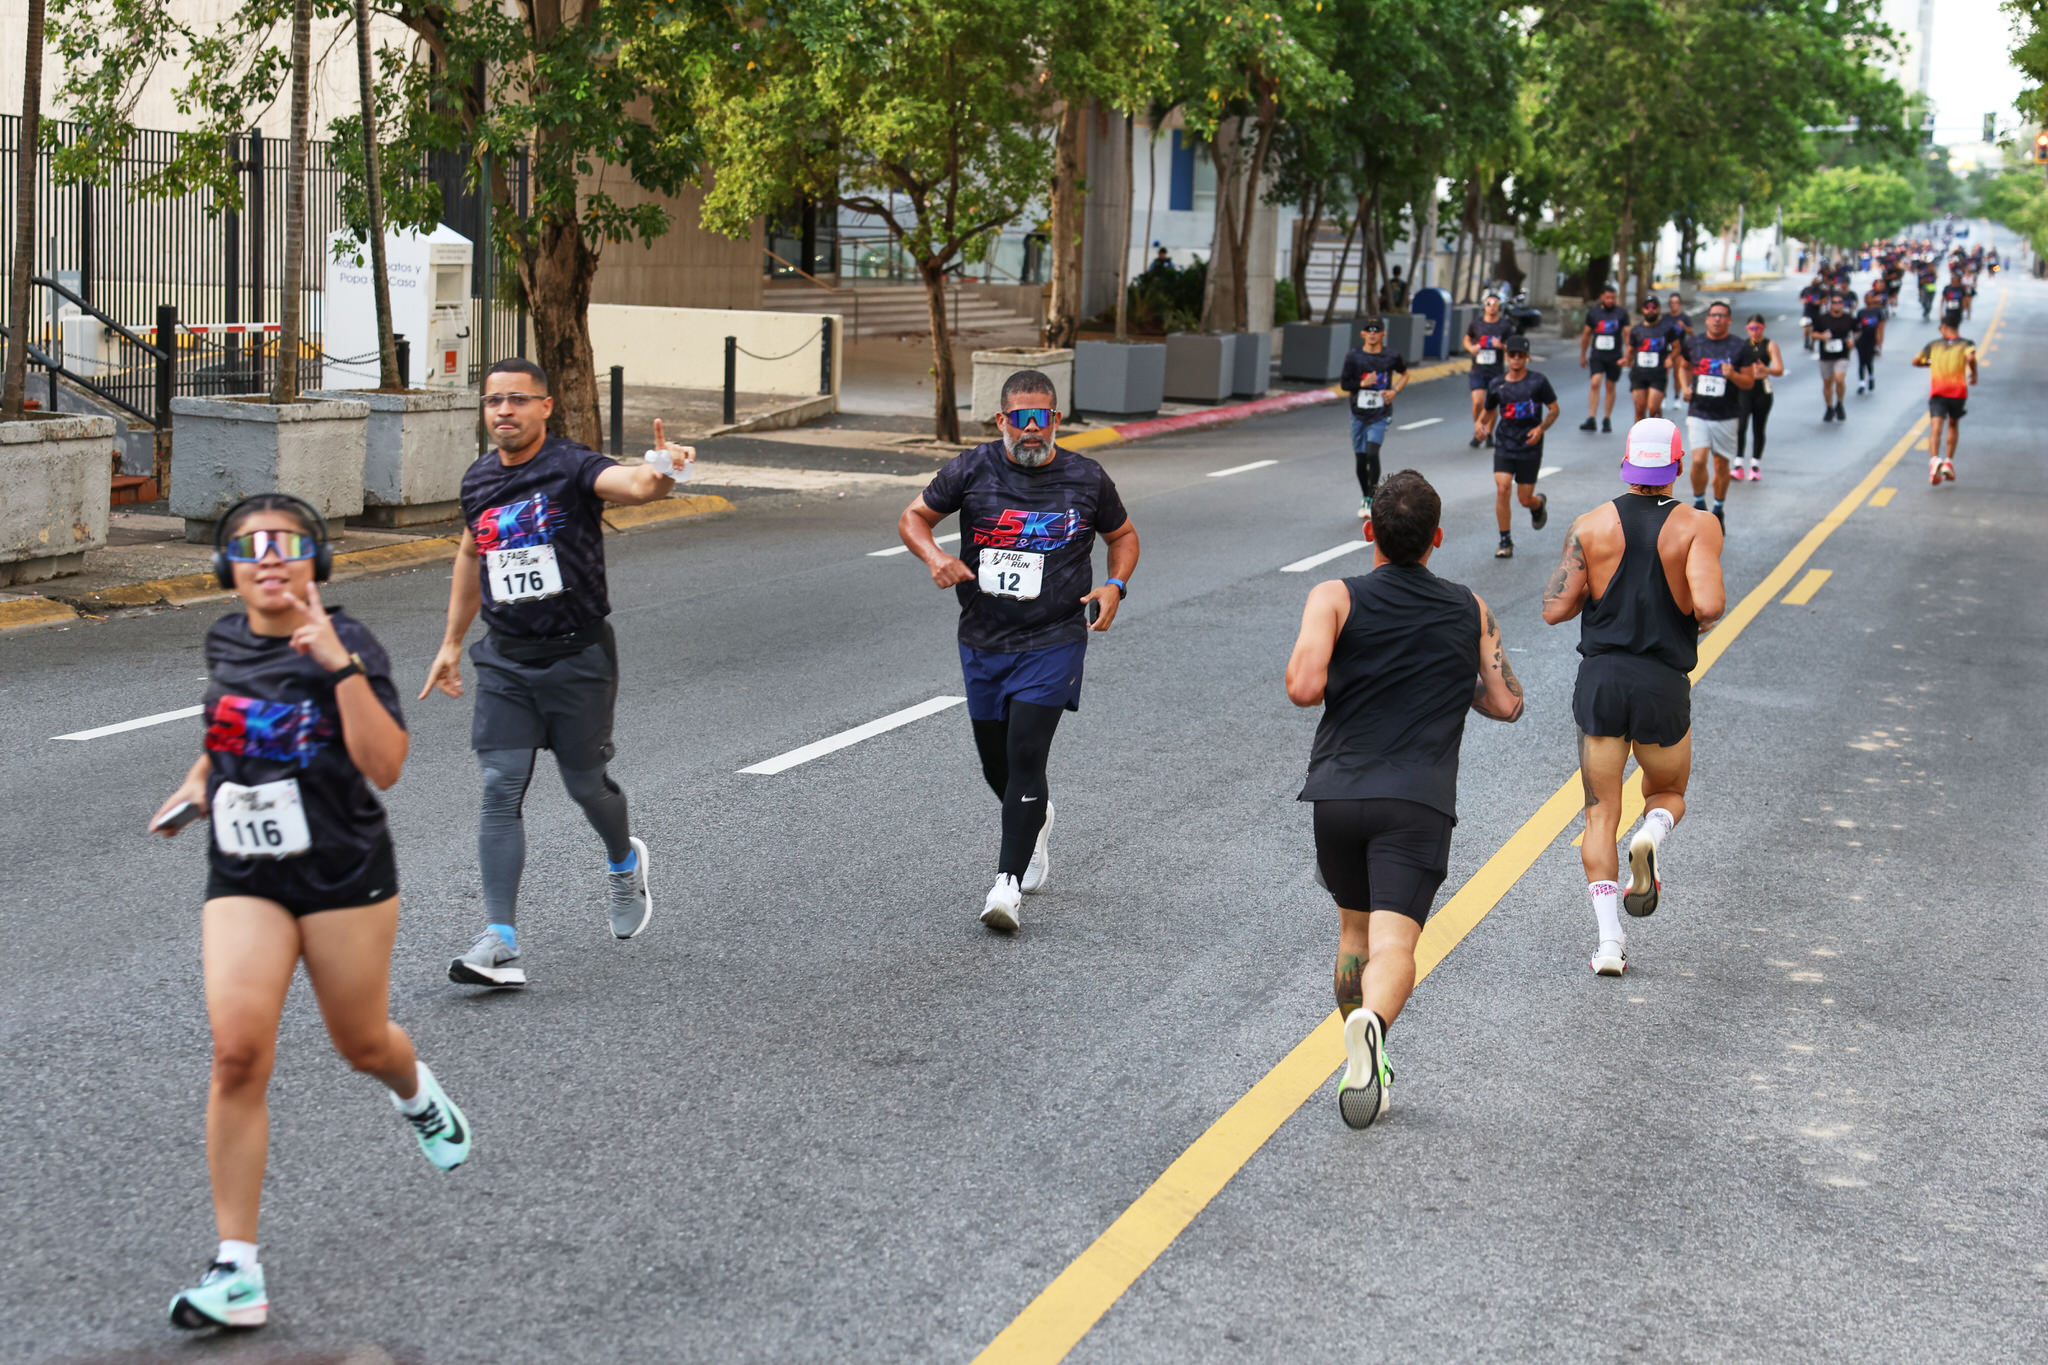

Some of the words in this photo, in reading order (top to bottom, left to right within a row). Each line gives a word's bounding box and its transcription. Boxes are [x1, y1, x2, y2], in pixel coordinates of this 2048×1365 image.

[415, 264, 421, 275] y
[389, 276, 417, 288] Casa
[476, 500, 531, 543] 5K
[990, 508, 1066, 538] 5K
[973, 532, 1018, 548] FADE
[1016, 538, 1029, 548] &
[507, 549, 530, 560] FADE
[520, 557, 540, 566] RUN
[1001, 552, 1024, 562] FADE
[1011, 560, 1031, 569] RUN
[503, 570, 544, 595] 176
[997, 571, 1021, 592] 12
[211, 695, 297, 740] 5K
[231, 819, 283, 847] 116
